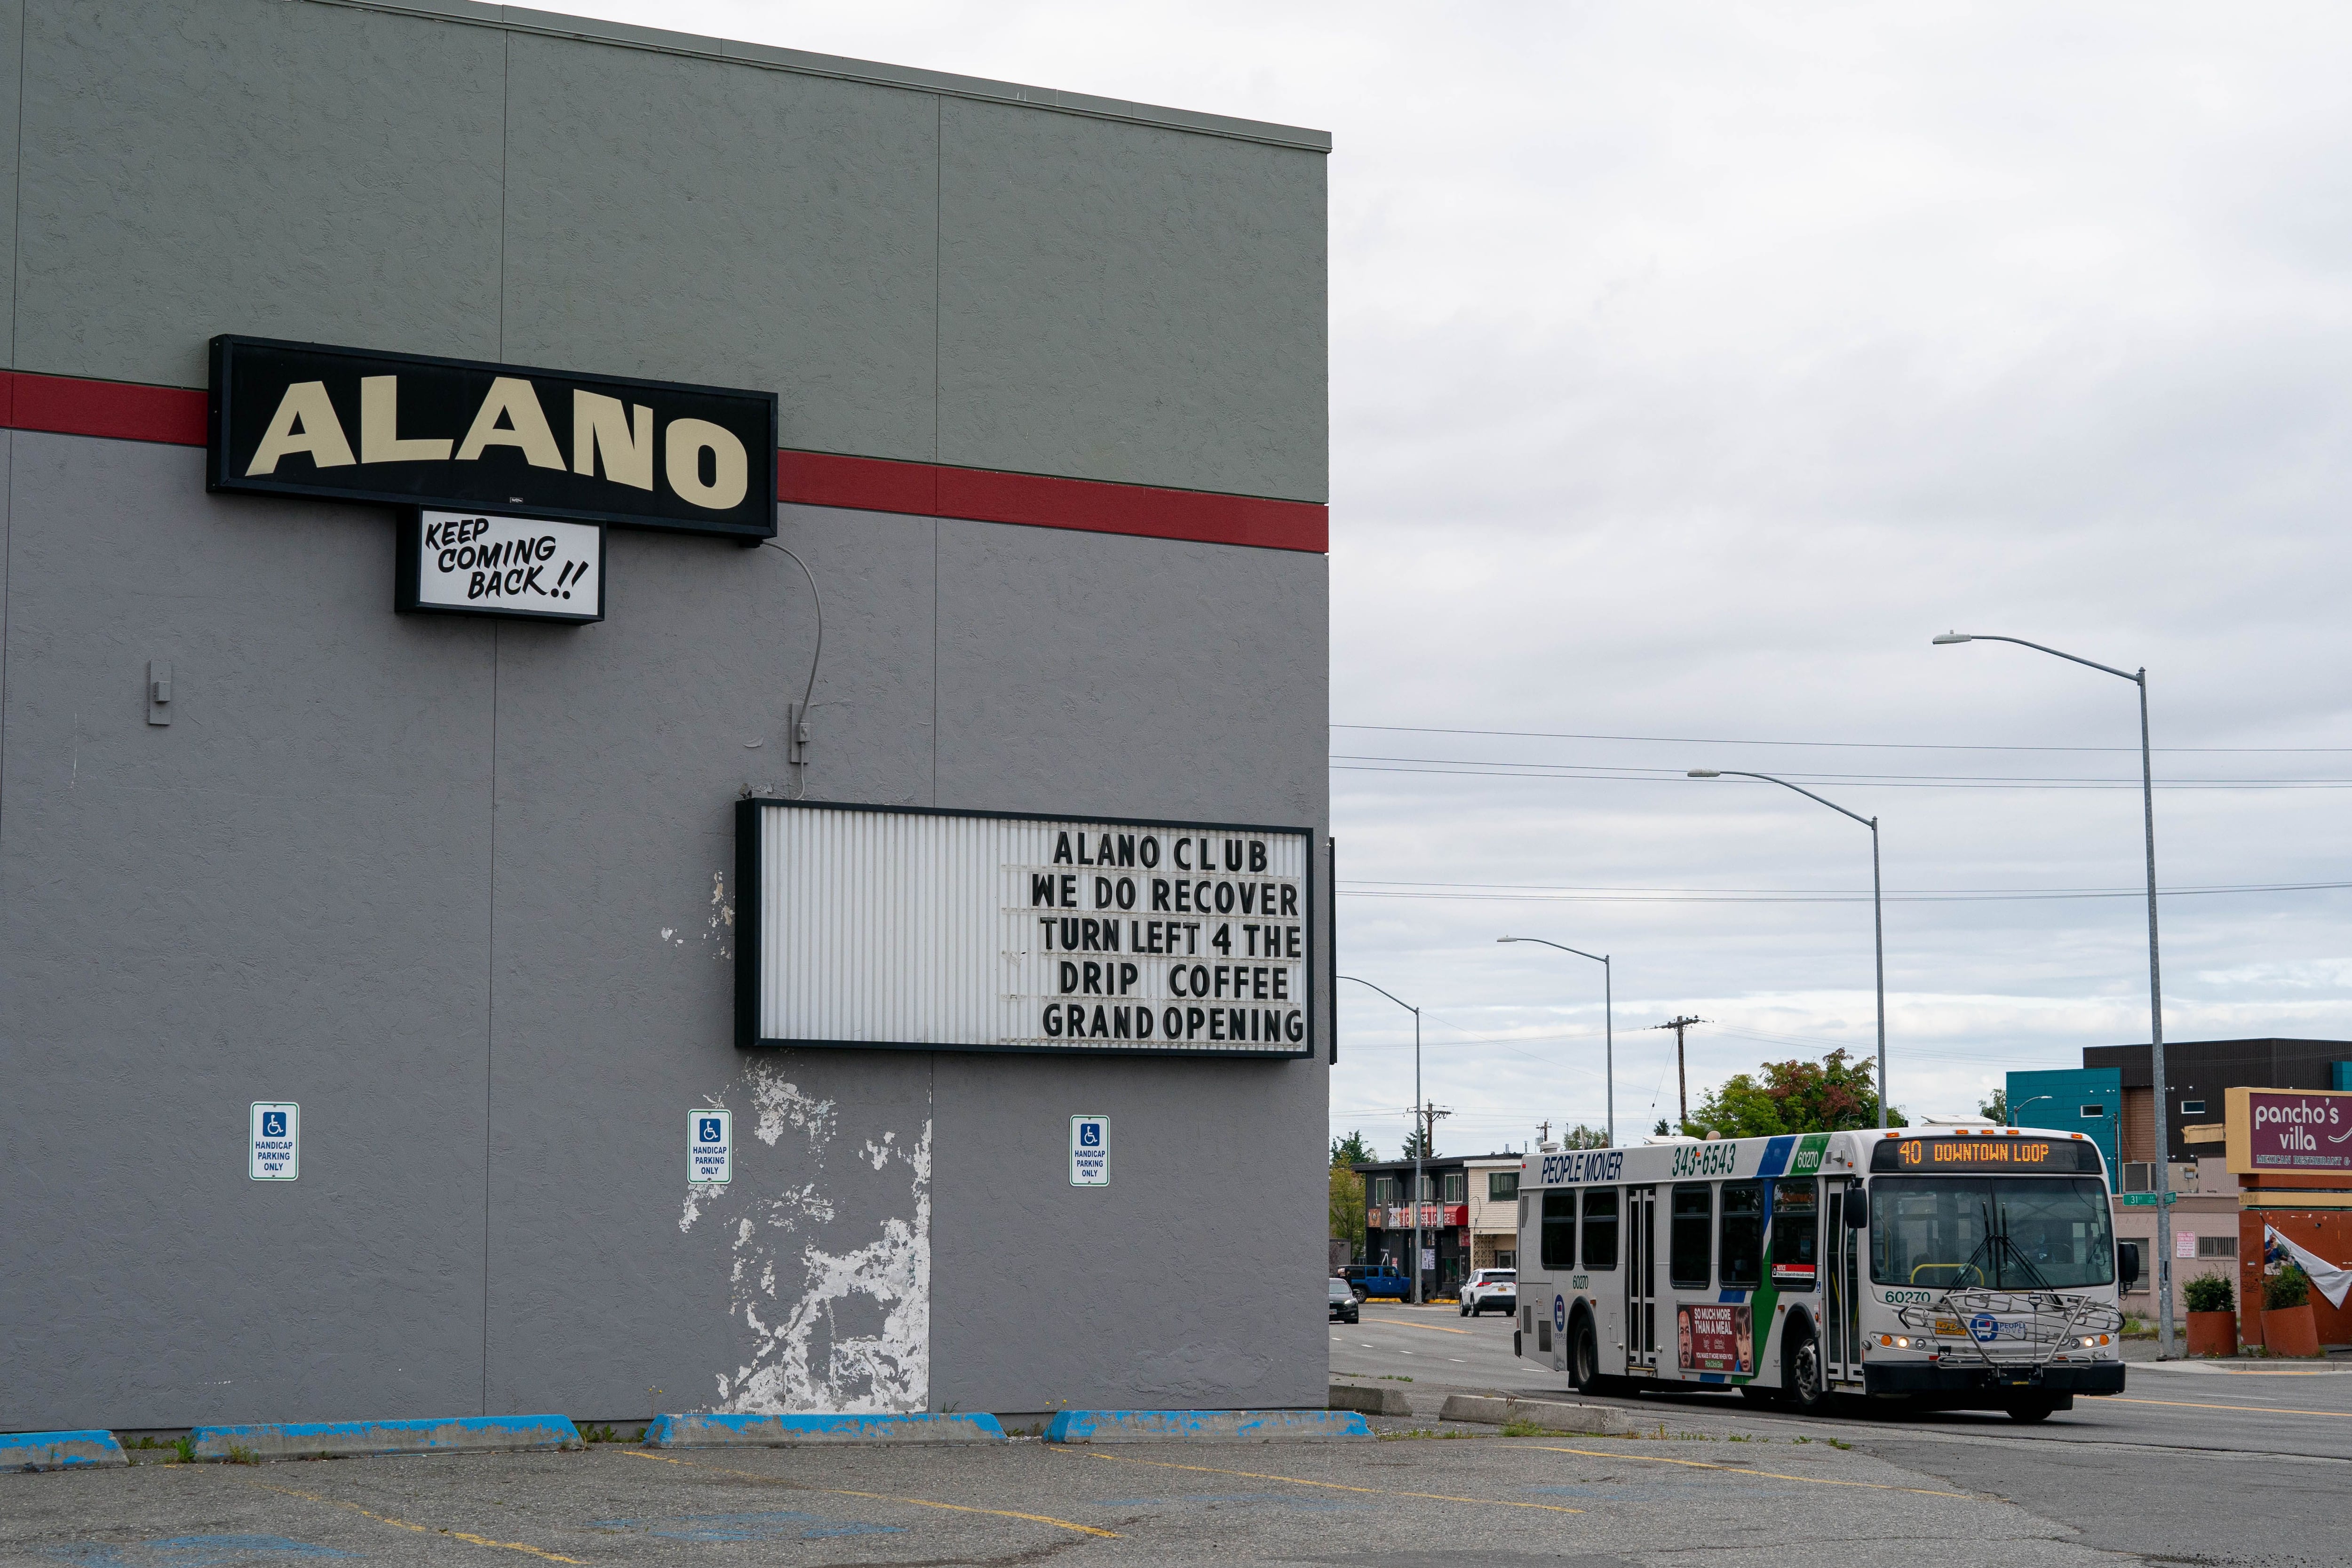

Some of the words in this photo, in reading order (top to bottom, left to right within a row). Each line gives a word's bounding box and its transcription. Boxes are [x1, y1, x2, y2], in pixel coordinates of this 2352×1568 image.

[246, 375, 747, 510] ALANO
[426, 518, 489, 550] KEEP
[438, 535, 556, 573] COMING
[1053, 831, 1160, 868] ALANO
[1173, 837, 1267, 872] CLUB
[1032, 874, 1077, 907] WE
[1095, 876, 1136, 910] DO
[1152, 878, 1298, 916] RECOVER
[1040, 917, 1119, 952] TURN
[1132, 920, 1200, 955] LEFT
[1211, 923, 1232, 955] 4
[1243, 924, 1301, 958] THE
[1060, 961, 1138, 995] DRIP
[1169, 963, 1288, 1000] COFFEE
[1042, 1003, 1154, 1038] GRAND
[1162, 1006, 1303, 1042] OPENING
[2255, 1098, 2339, 1130] pancho's
[1899, 1140, 1922, 1164] 40
[1934, 1143, 2009, 1162] DOWNTOWN
[2013, 1144, 2049, 1162] LOOP
[2279, 1125, 2317, 1150] villa
[1542, 1155, 1582, 1184] PEOPLE
[1583, 1152, 1623, 1181] MOVER
[1672, 1143, 1736, 1177] 343-6543
[1797, 1151, 1819, 1169] 60270
[2256, 1154, 2291, 1164] MEXICAN
[2293, 1155, 2342, 1166] RESTAURANT
[2344, 1156, 2351, 1166] &
[1573, 1275, 1589, 1289] 60270
[1885, 1290, 1931, 1303] 60270
[1694, 1308, 1701, 1320] SO
[1701, 1308, 1716, 1320] MUCH
[1716, 1308, 1731, 1320] MORE
[1694, 1321, 1710, 1334] THAN
[1711, 1321, 1716, 1334] A
[1716, 1321, 1732, 1335] MEAL
